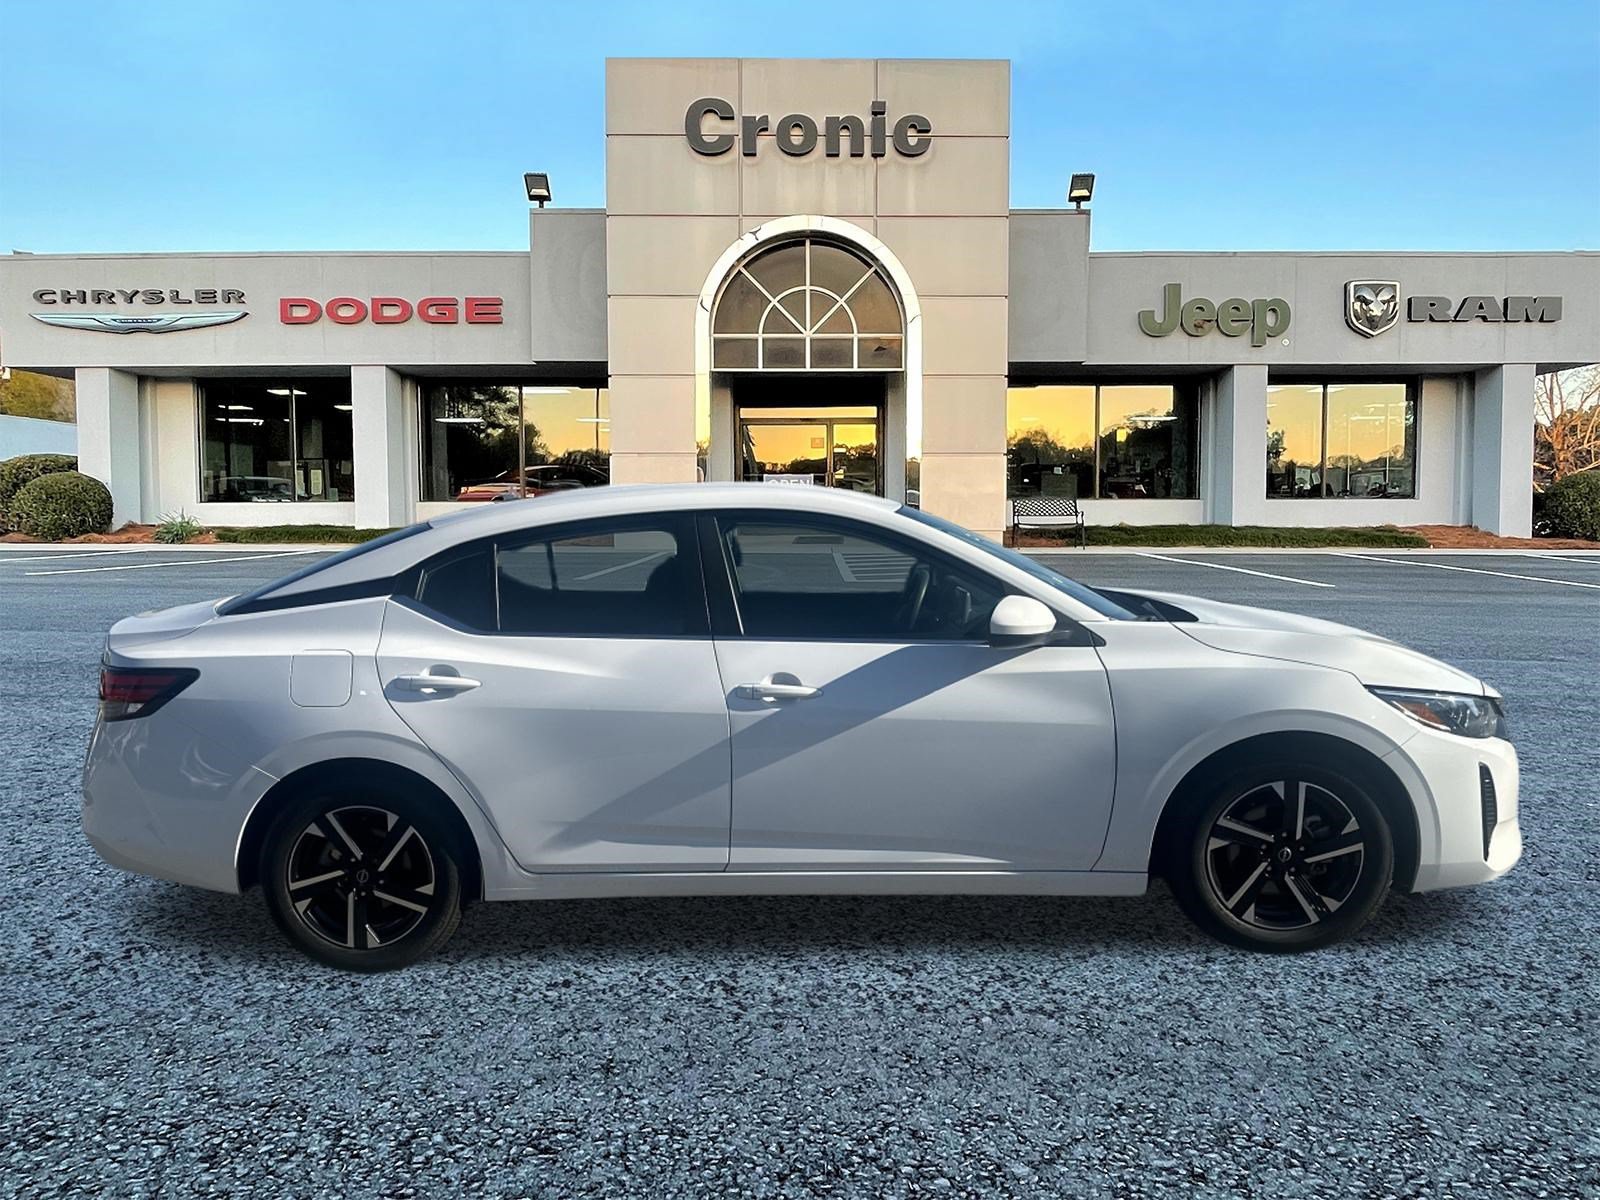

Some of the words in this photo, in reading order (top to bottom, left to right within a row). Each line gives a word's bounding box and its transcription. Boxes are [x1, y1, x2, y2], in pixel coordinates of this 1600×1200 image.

[685, 97, 932, 157] Cronic
[32, 288, 246, 305] CHRYSLER
[1408, 296, 1563, 323] RAM
[280, 297, 503, 325] DODGE
[1139, 283, 1291, 346] Jeep
